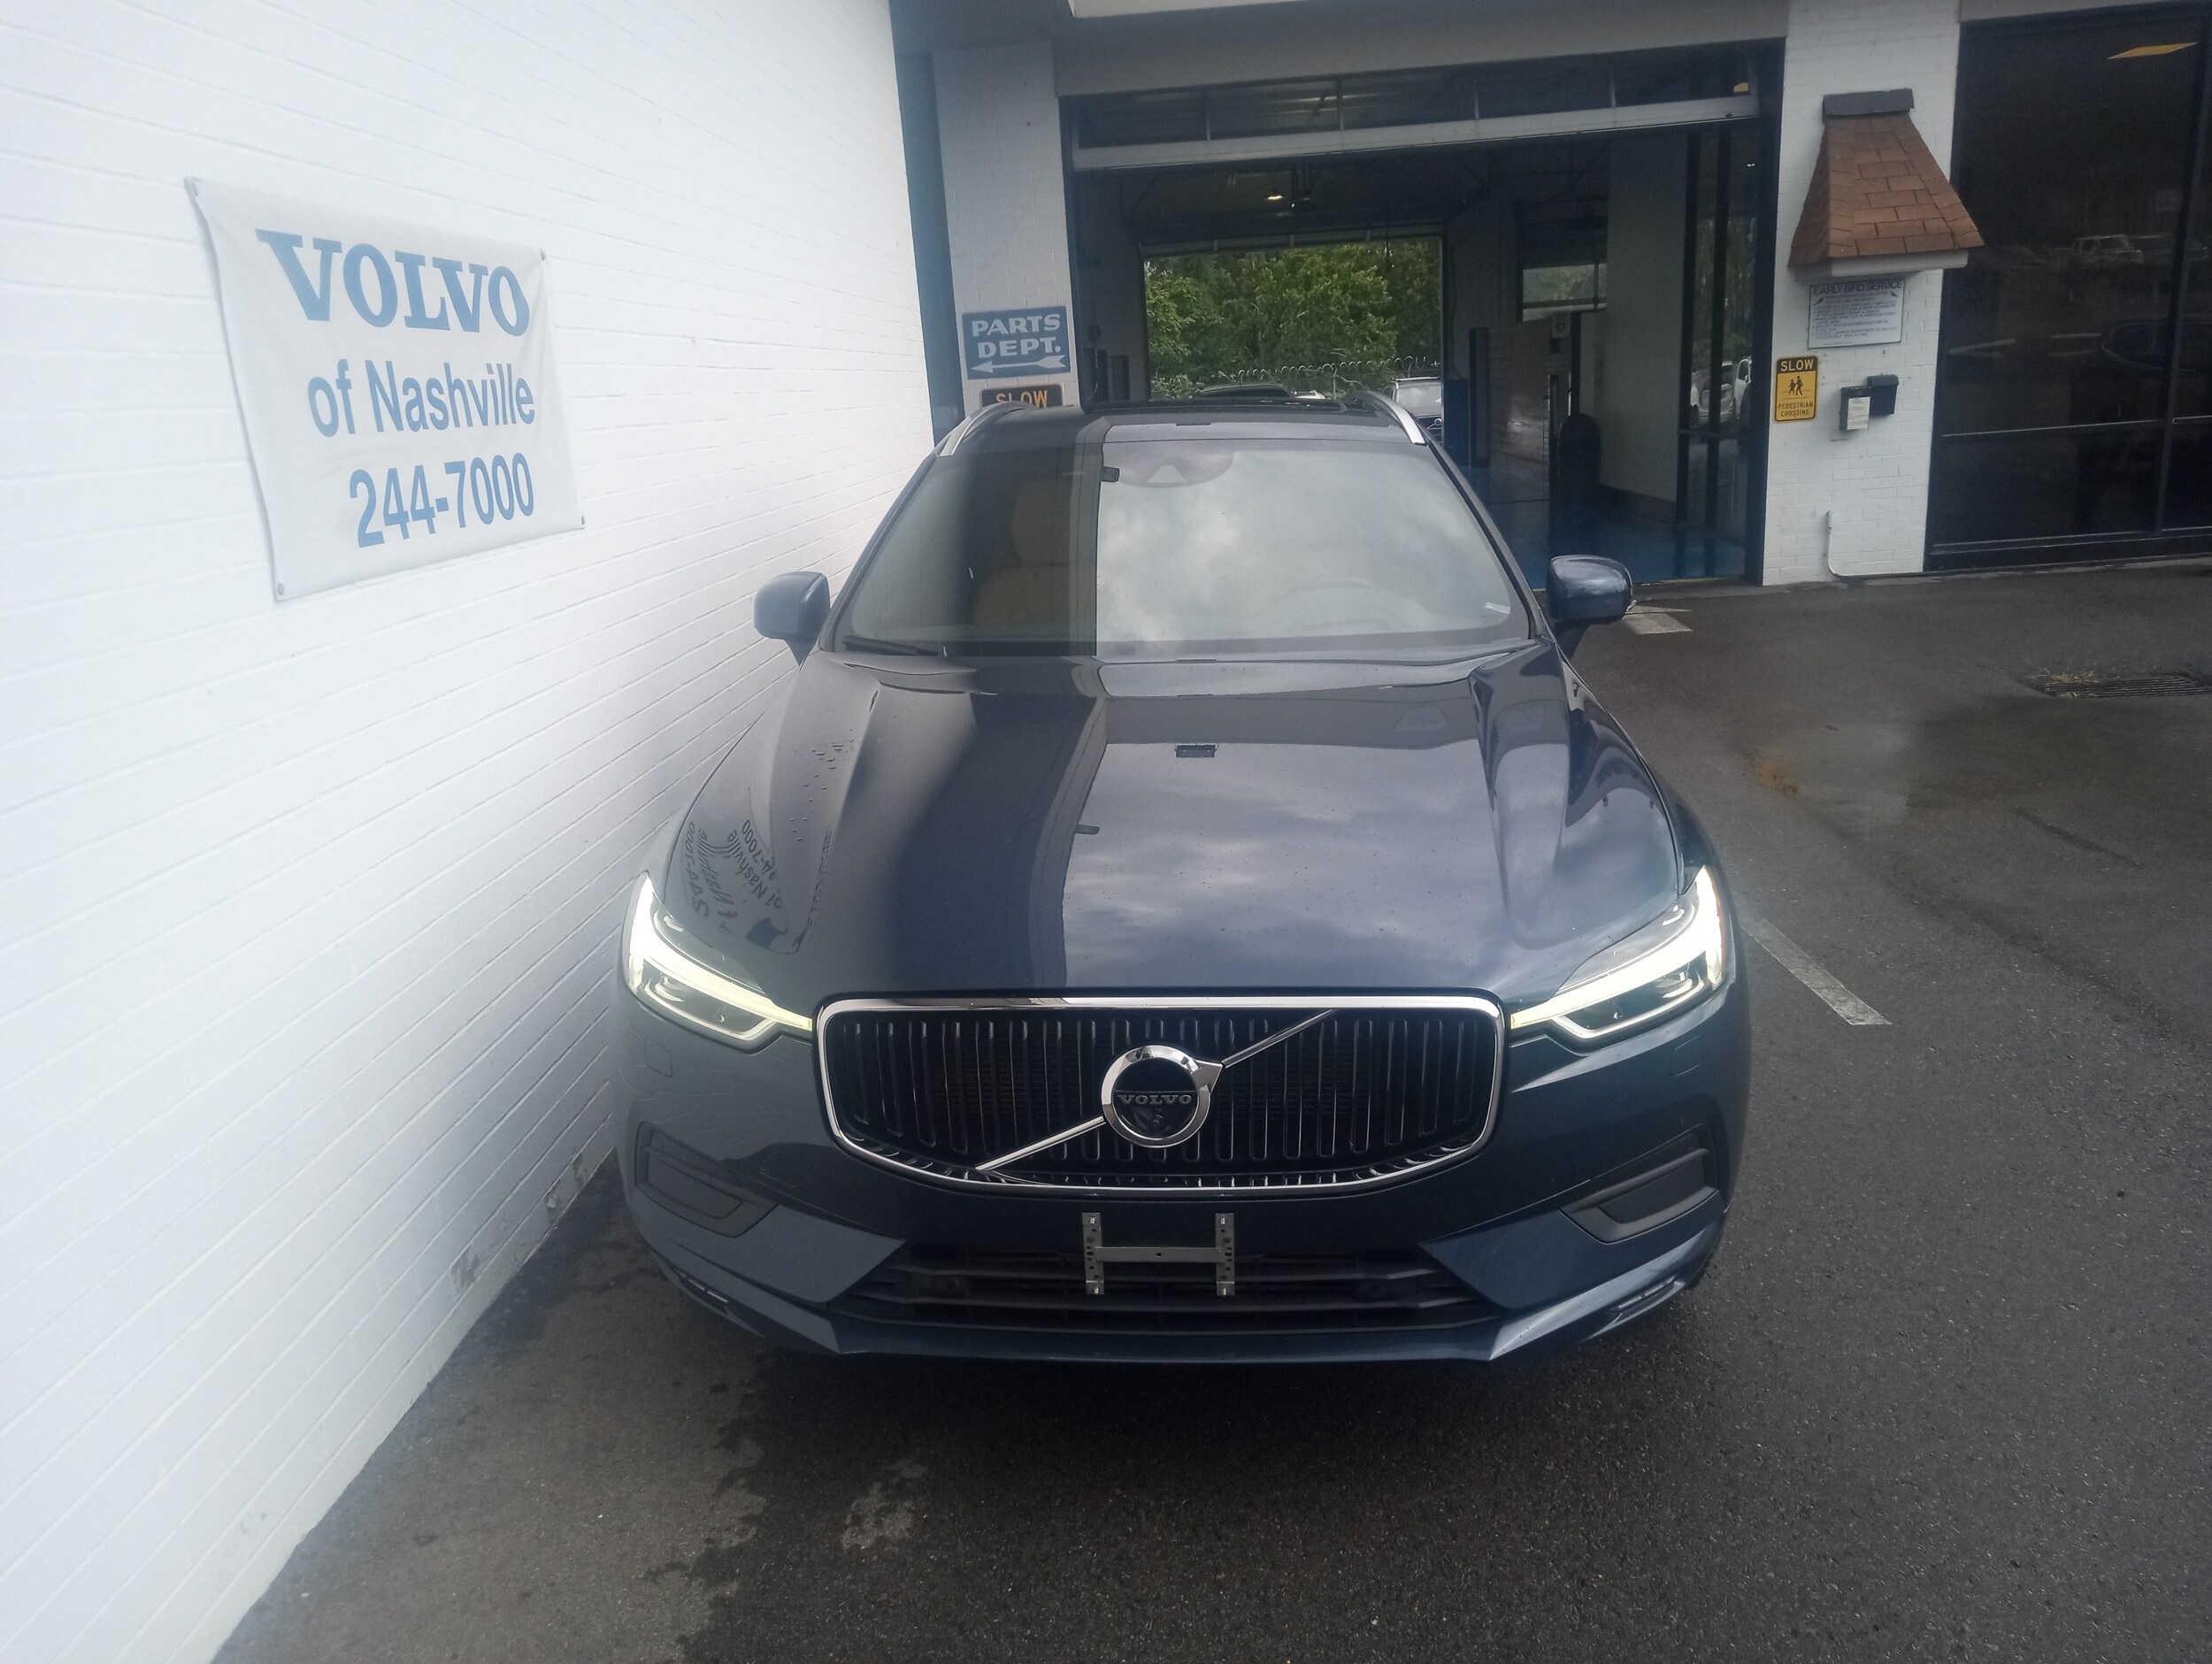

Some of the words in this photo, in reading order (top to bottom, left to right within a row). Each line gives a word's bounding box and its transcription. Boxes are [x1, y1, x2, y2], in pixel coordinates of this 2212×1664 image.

[255, 228, 530, 337] VOLVO
[1814, 284, 1843, 295] EARLY
[1844, 283, 1865, 293] BIRD
[1867, 280, 1902, 291] SERVICE
[972, 313, 1061, 337] PARTS
[977, 337, 1062, 358] DEPT.
[1780, 358, 1814, 372] SLOW
[307, 358, 356, 438] of
[365, 359, 535, 433] Nashville
[1778, 401, 1813, 410] PEDESTRIAN
[349, 452, 534, 548] 244-7000
[1118, 1094, 1192, 1105] VOLVO
